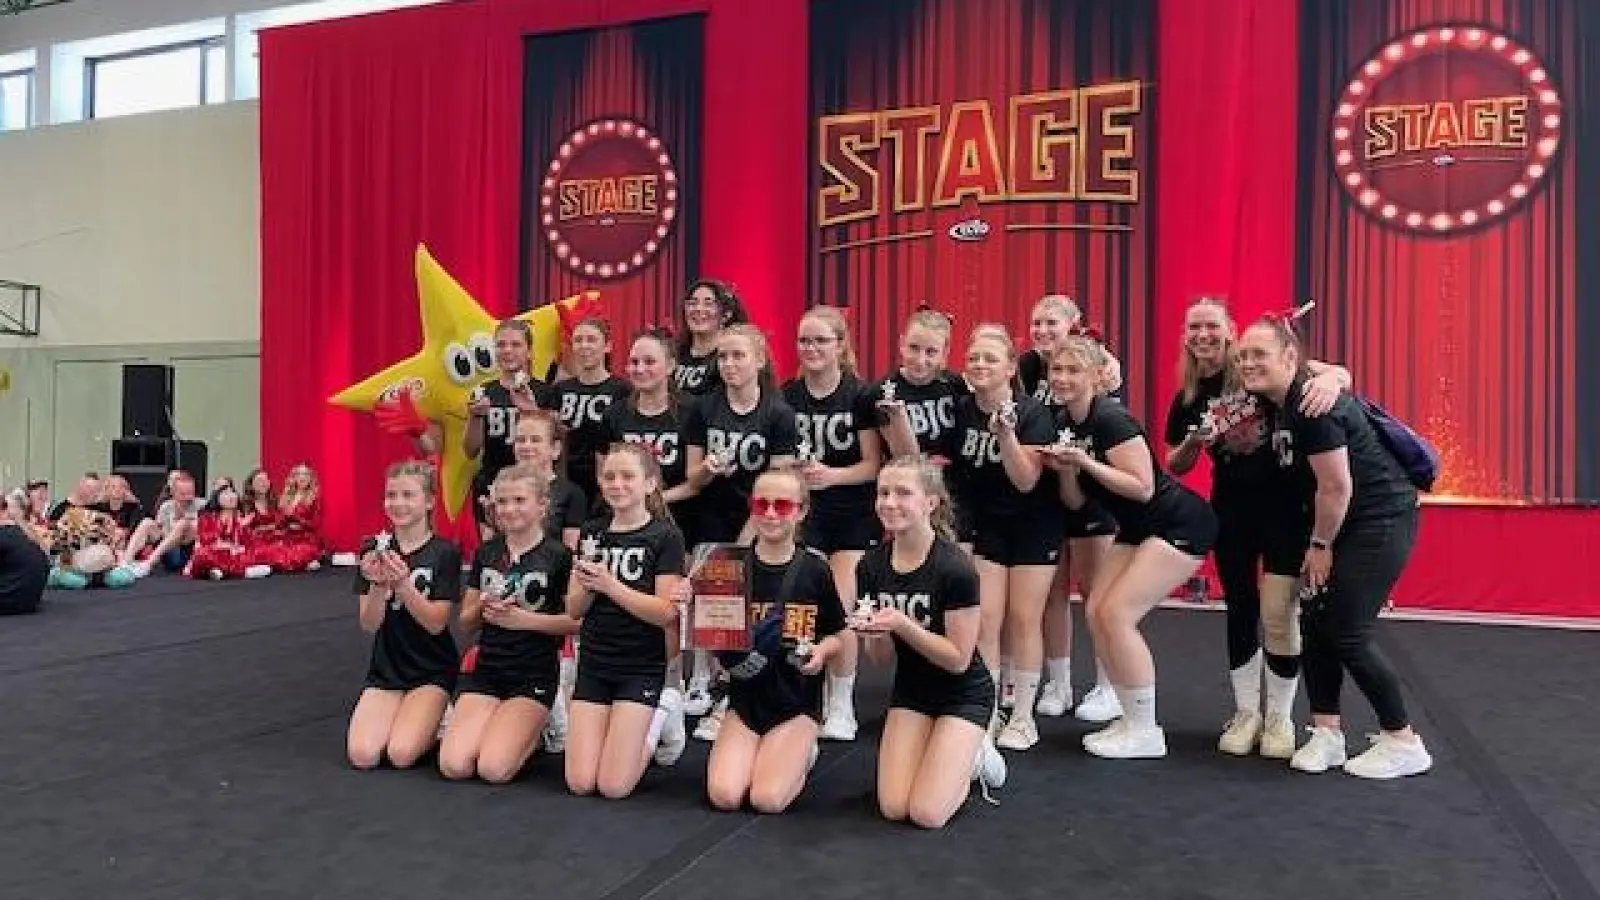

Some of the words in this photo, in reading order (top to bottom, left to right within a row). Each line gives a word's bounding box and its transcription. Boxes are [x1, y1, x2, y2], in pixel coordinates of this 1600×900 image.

[1364, 96, 1528, 160] STAGE
[820, 80, 1140, 227] STAGE
[559, 175, 658, 220] STAGE
[488, 406, 520, 444] BJ
[559, 392, 612, 428] BJC
[905, 396, 955, 440] BJC
